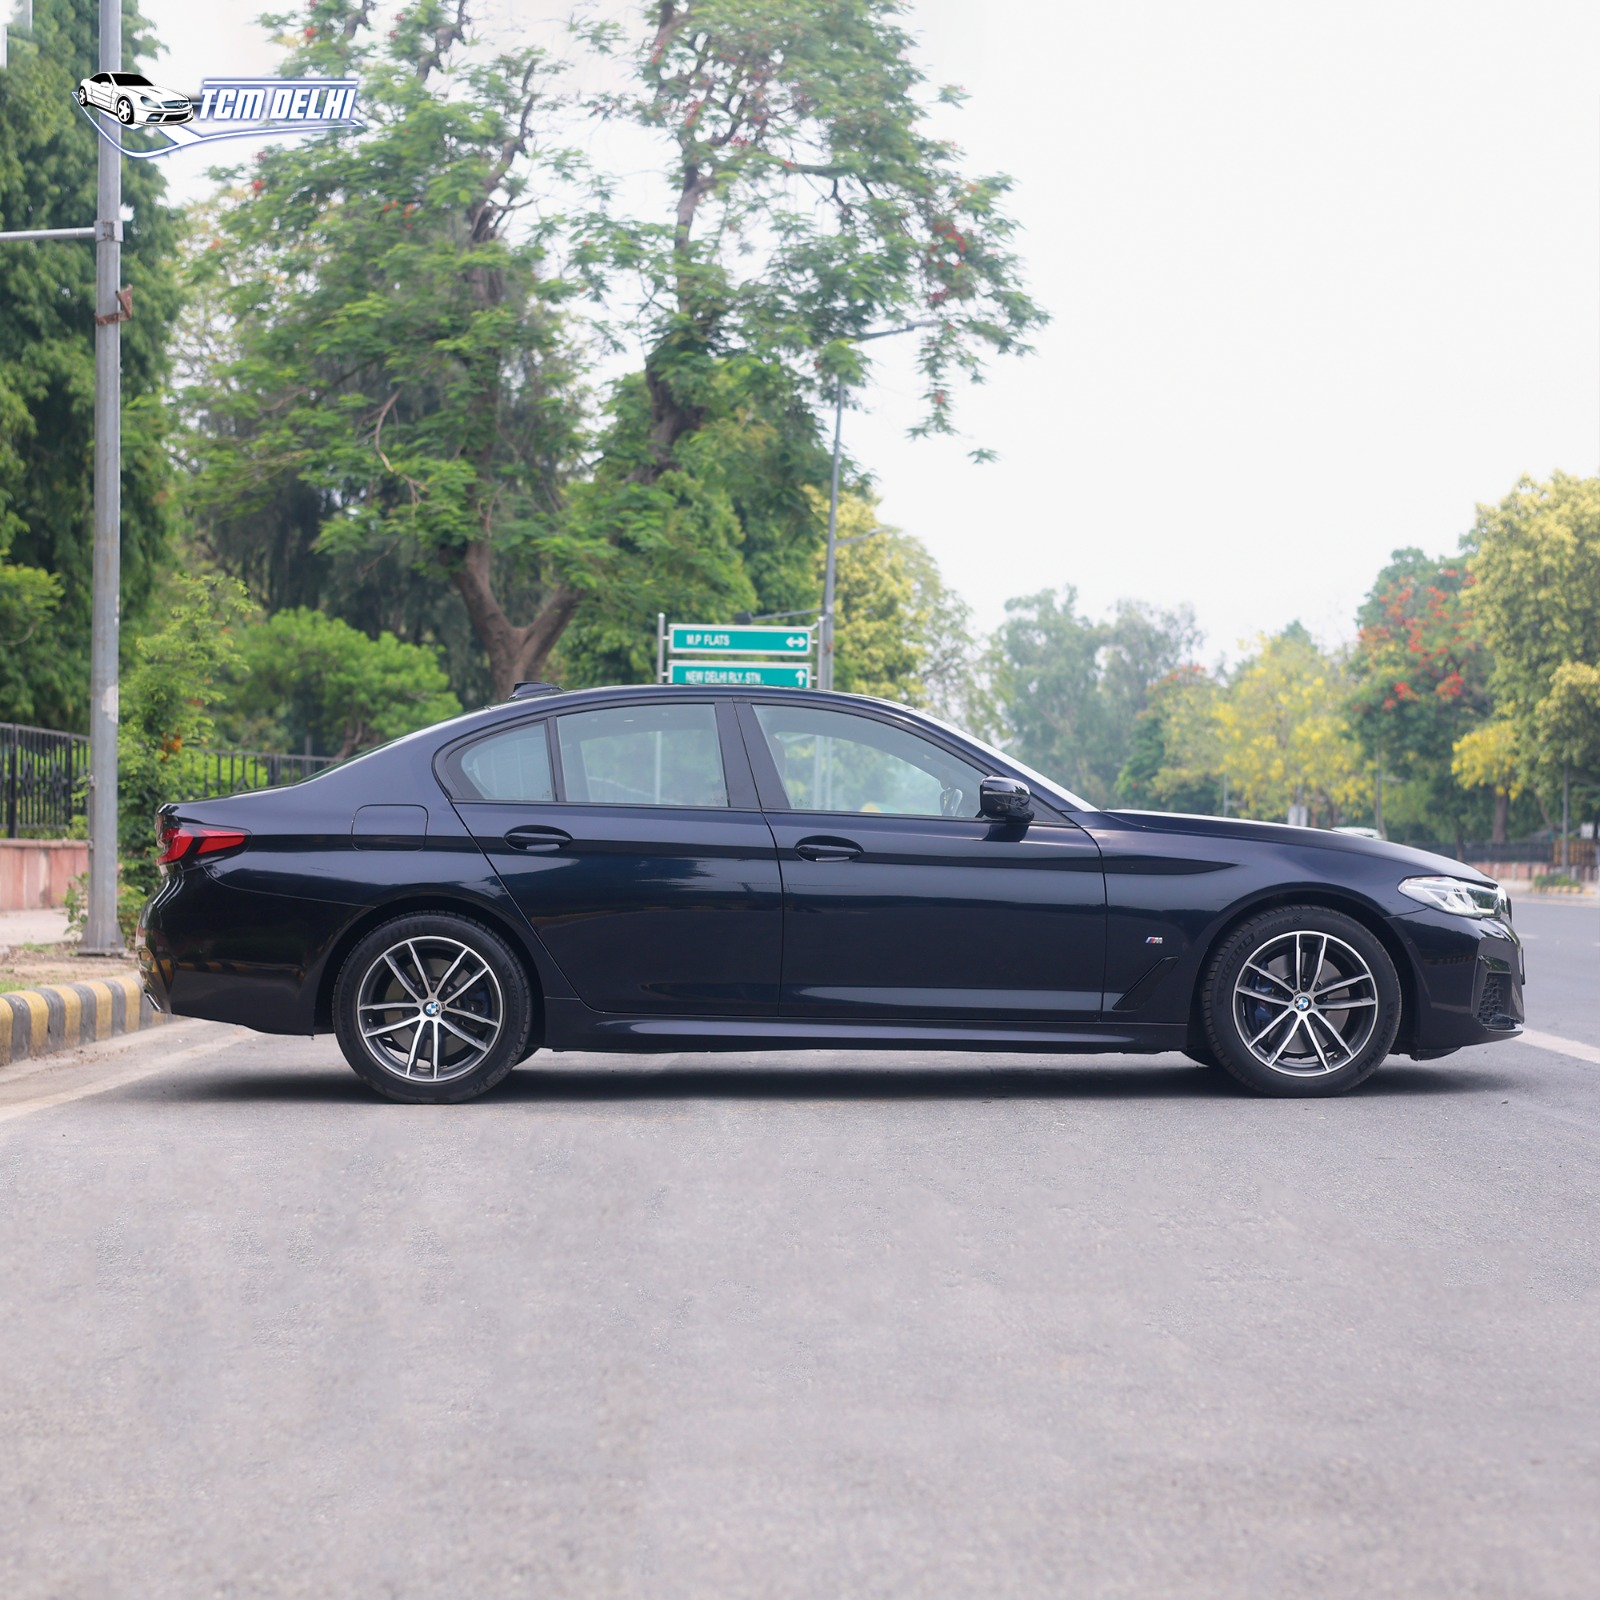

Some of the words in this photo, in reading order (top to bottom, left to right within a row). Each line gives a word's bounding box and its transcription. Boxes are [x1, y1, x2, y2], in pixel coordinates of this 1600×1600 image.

[703, 634, 730, 646] FLATS
[685, 671, 704, 684] NEW
[704, 671, 727, 684] DELHI
